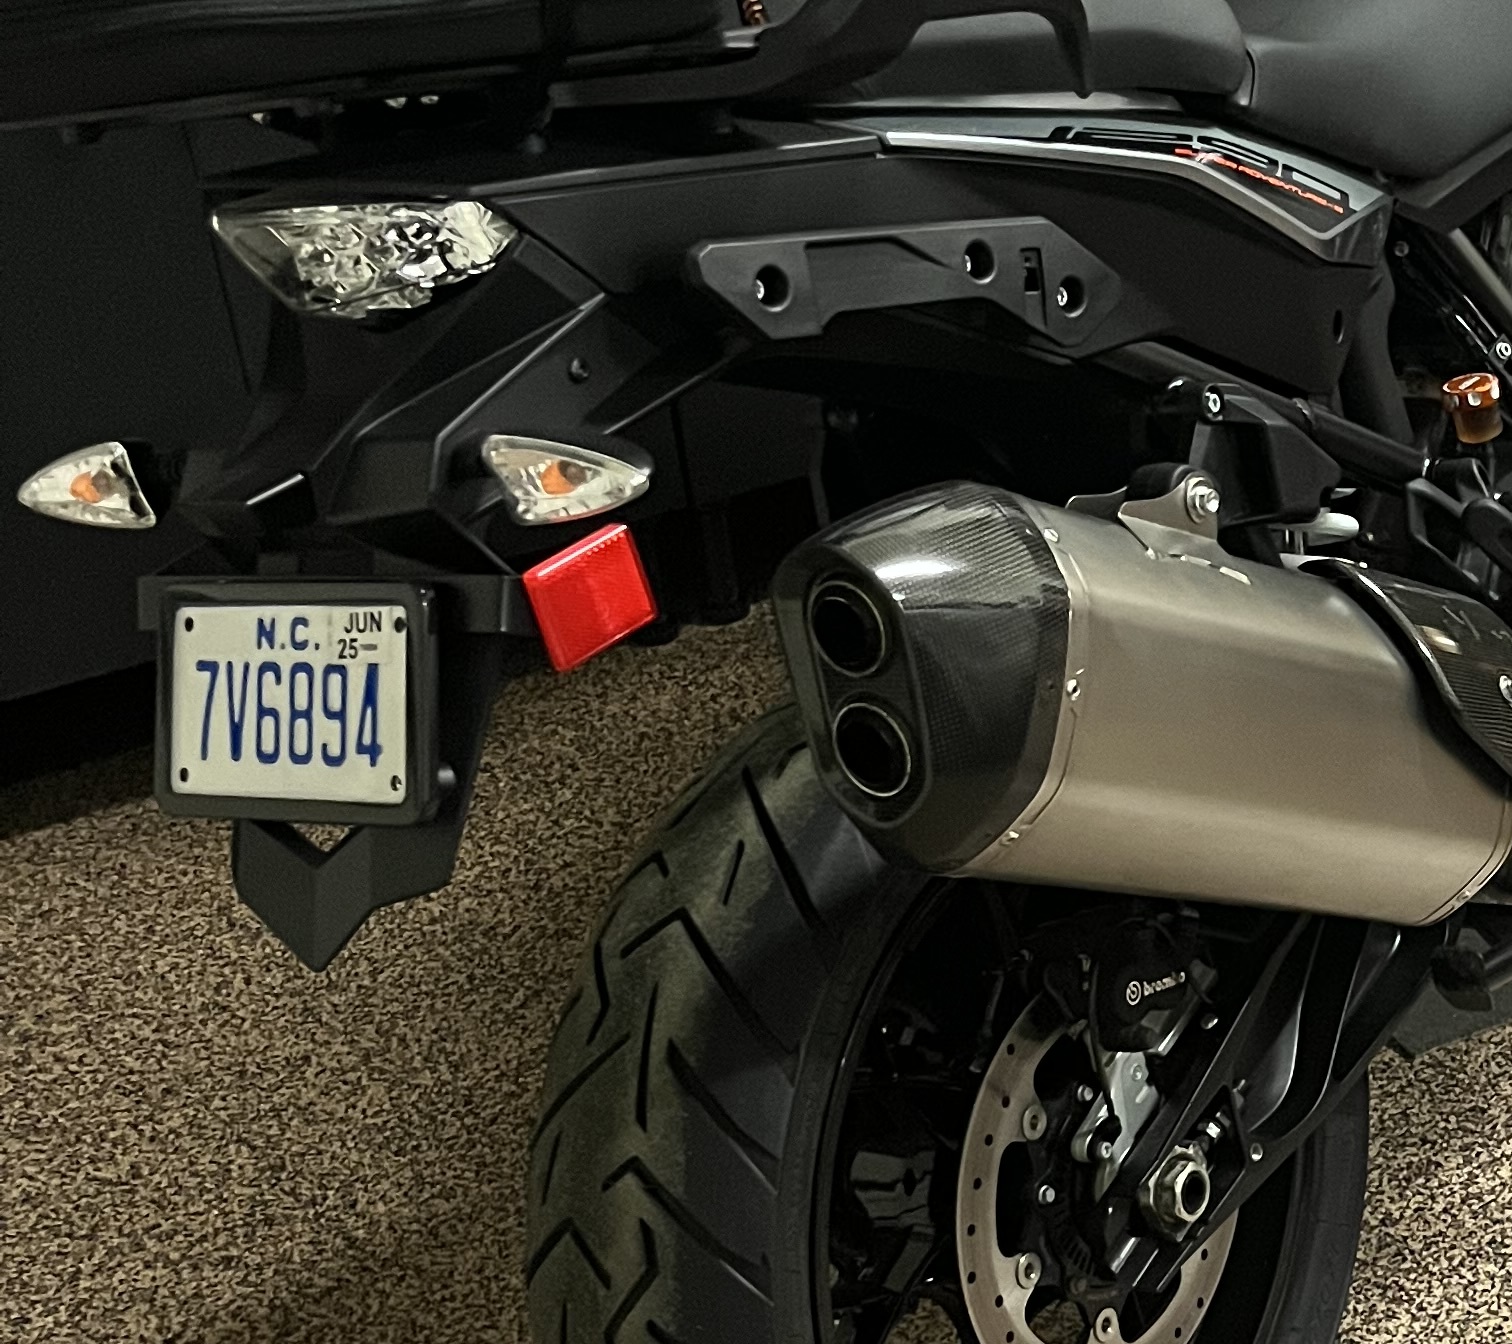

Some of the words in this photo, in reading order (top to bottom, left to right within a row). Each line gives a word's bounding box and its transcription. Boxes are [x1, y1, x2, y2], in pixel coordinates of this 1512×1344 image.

[256, 616, 320, 651] N.C.
[344, 610, 382, 634] JUN
[337, 638, 358, 659] 25
[196, 660, 383, 768] 7V6894
